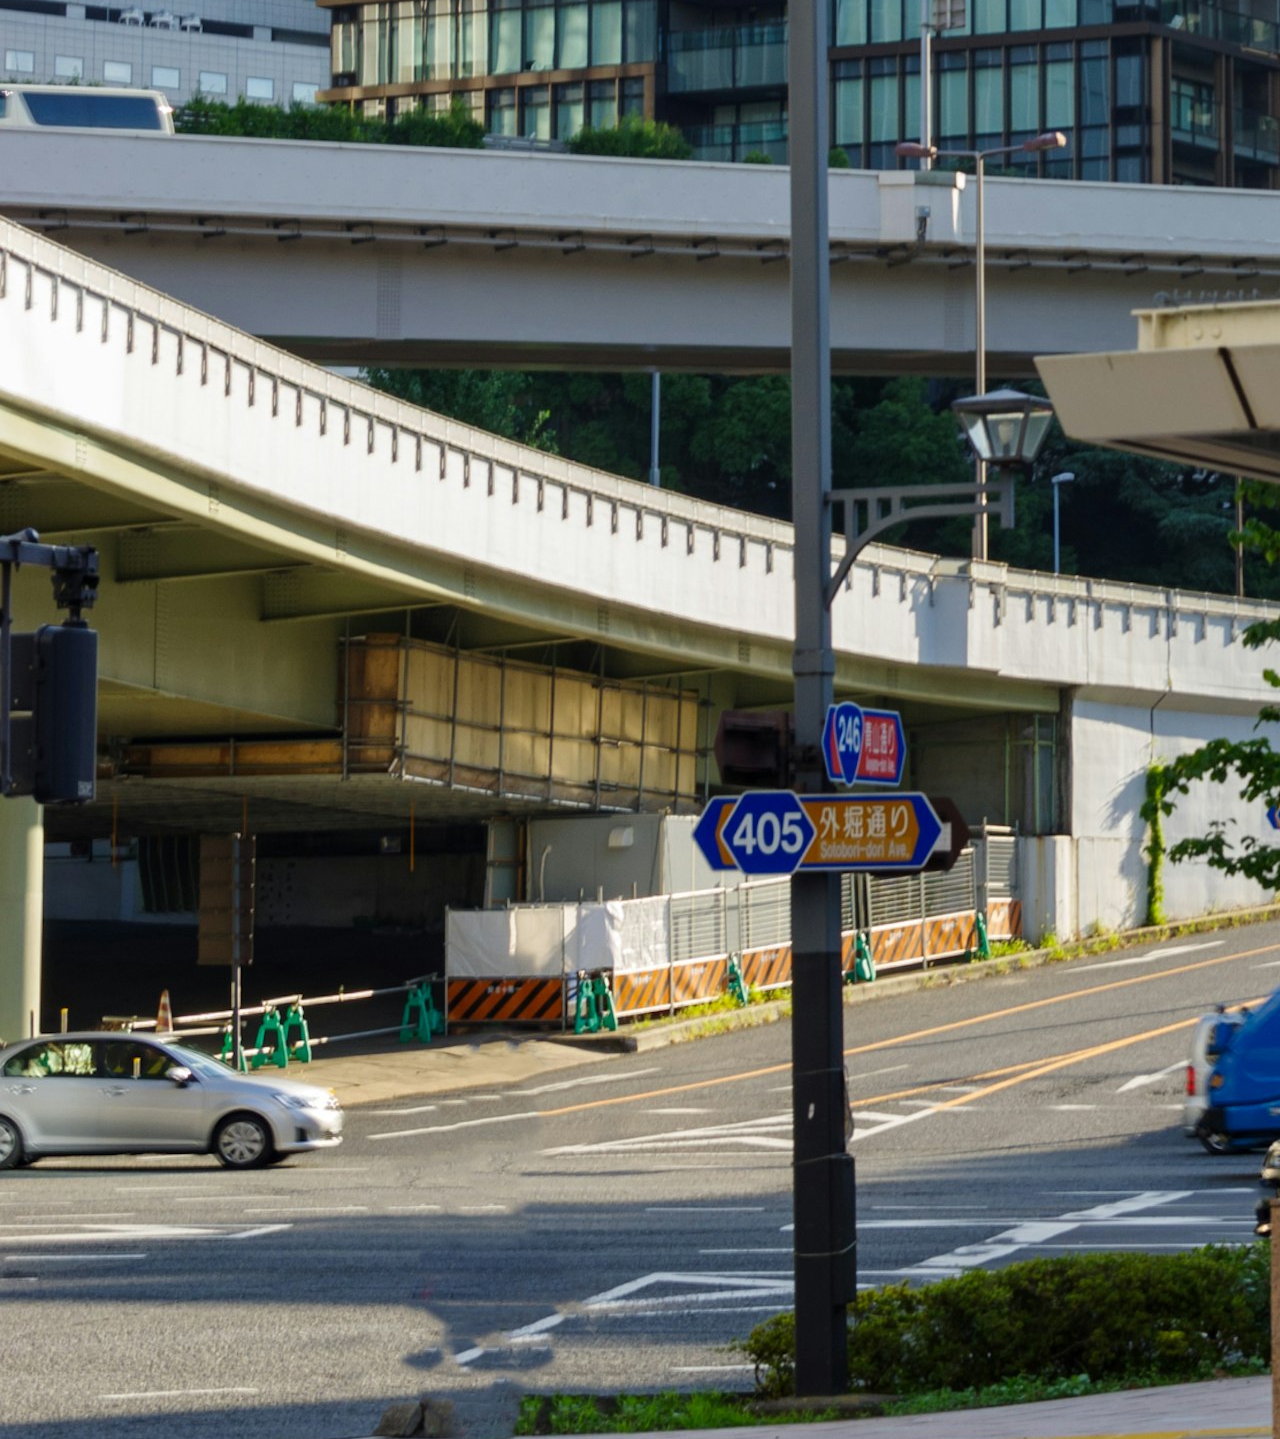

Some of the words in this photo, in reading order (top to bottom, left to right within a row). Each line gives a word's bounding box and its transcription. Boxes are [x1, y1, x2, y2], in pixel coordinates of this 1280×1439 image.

[838, 715, 861, 754] 246
[732, 811, 804, 855] 405
[819, 805, 909, 839] 外堀通り
[820, 841, 884, 859] Sotobori-dori
